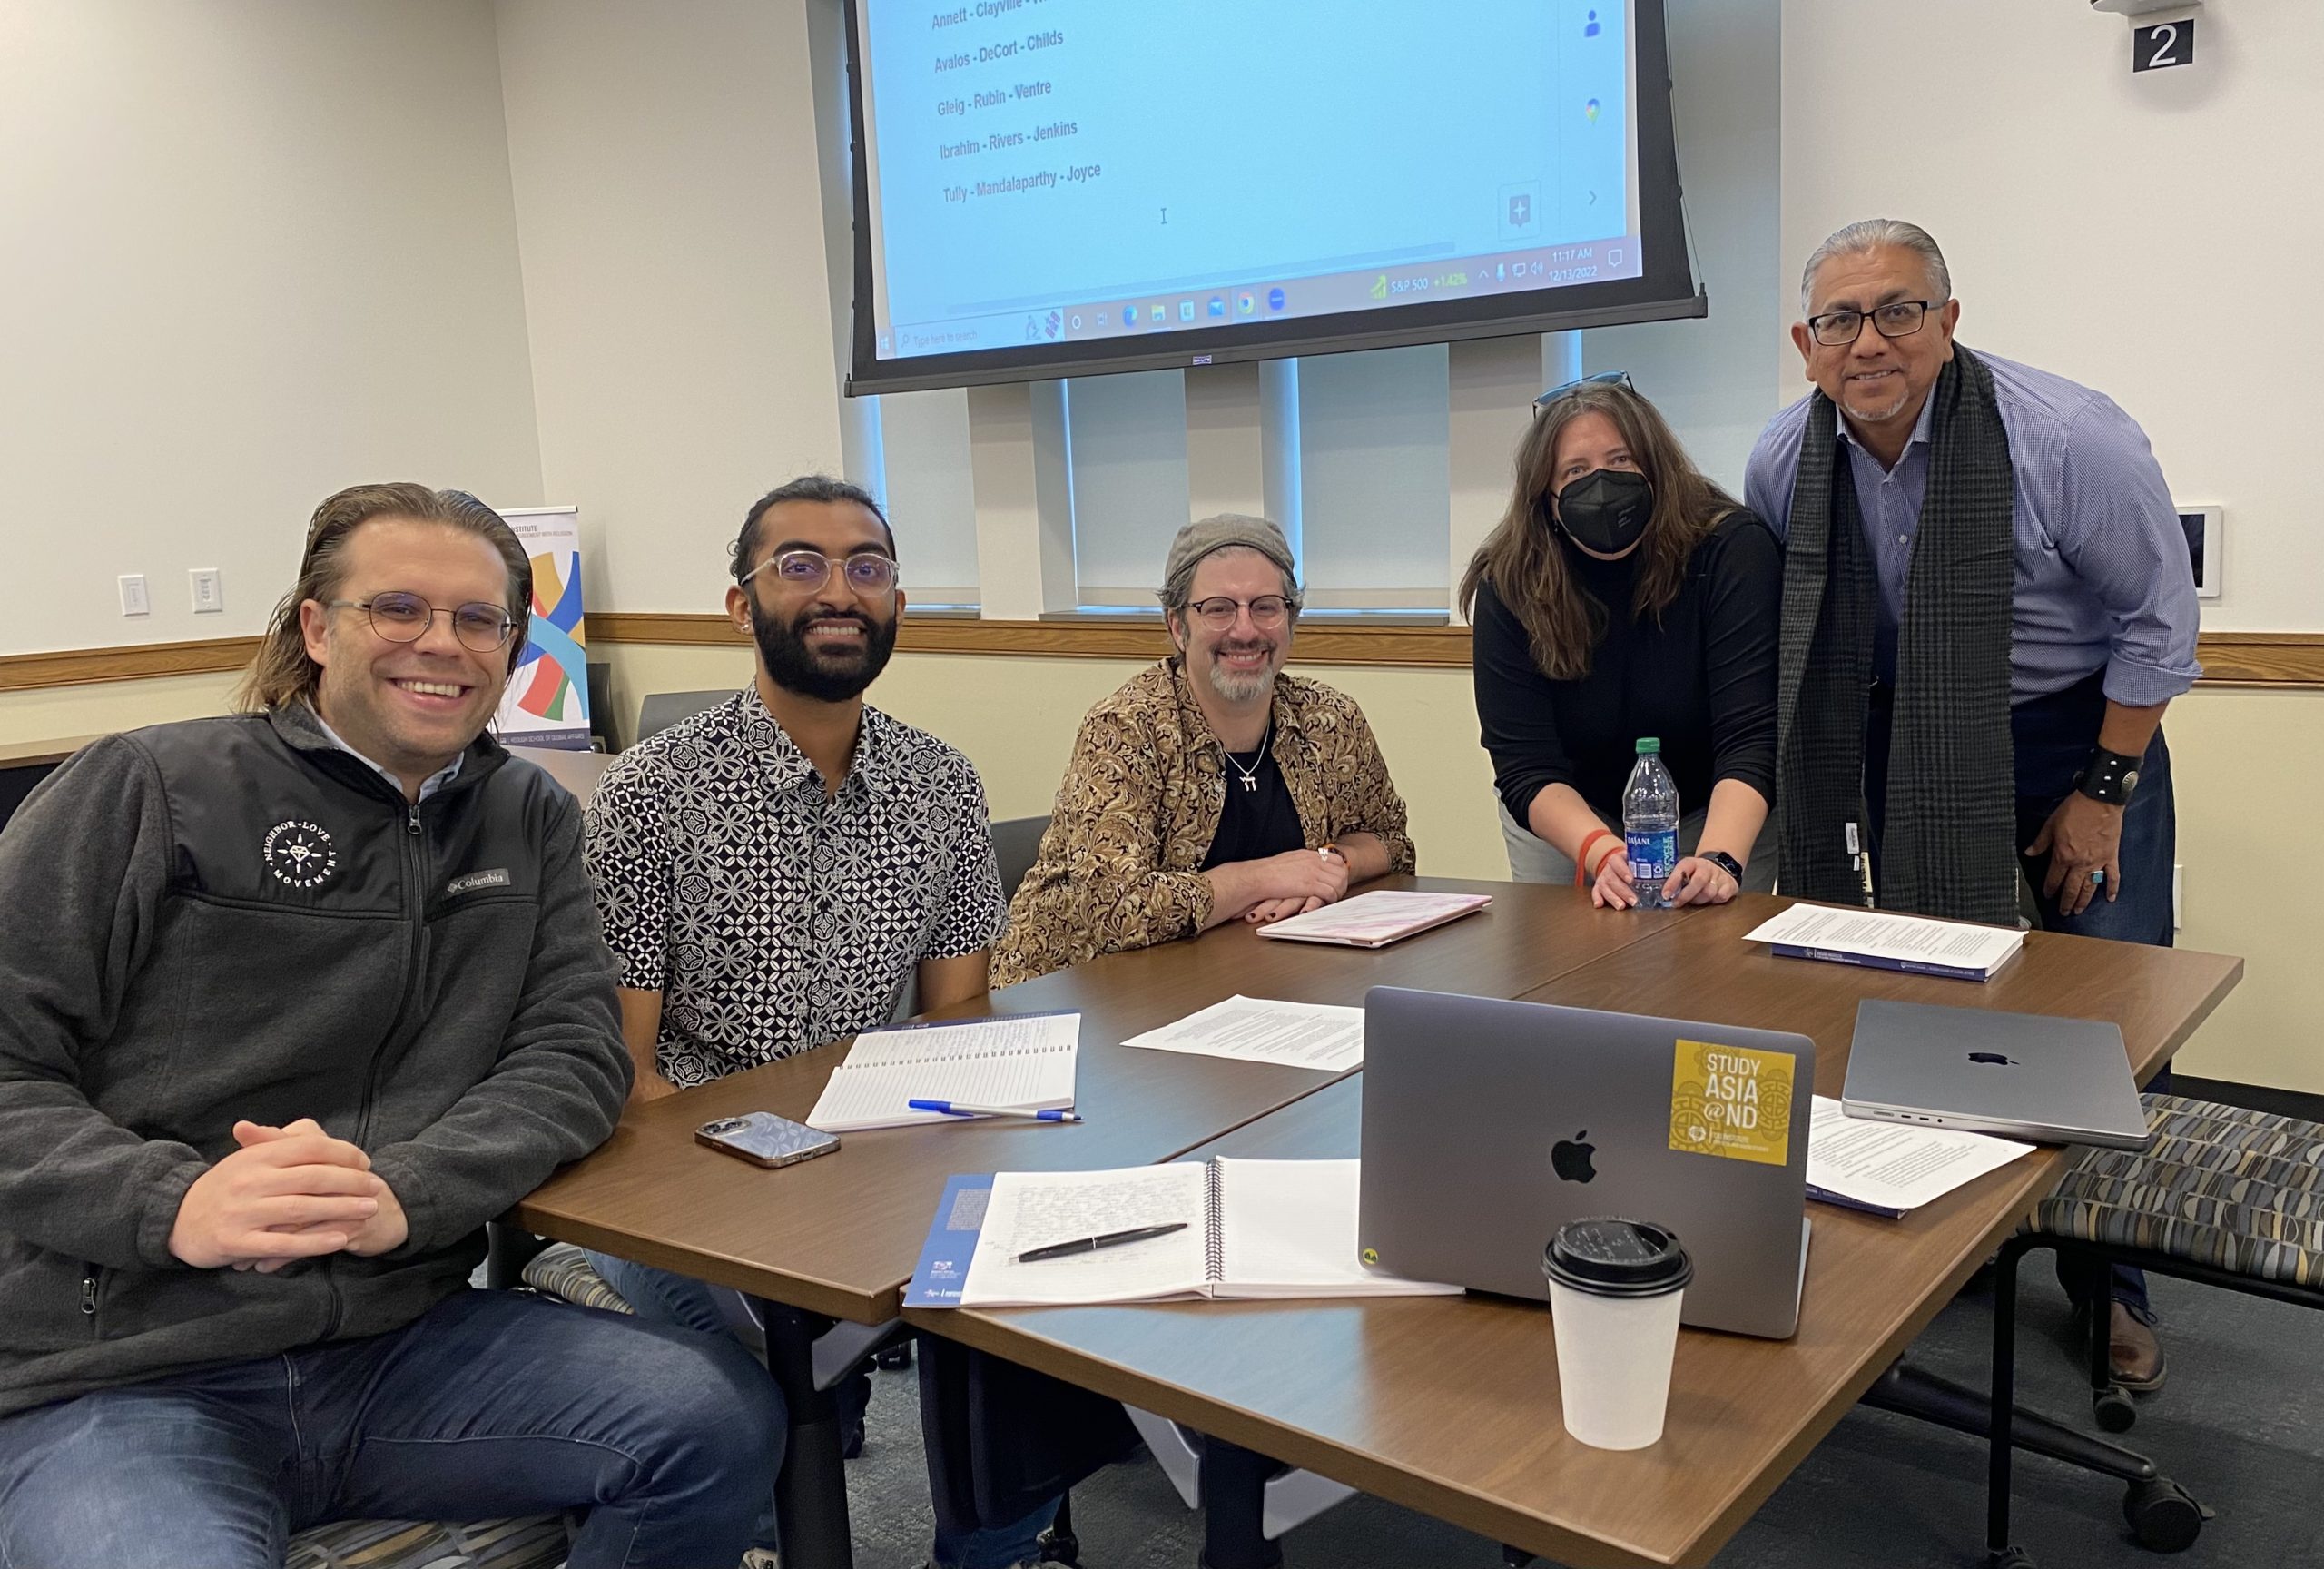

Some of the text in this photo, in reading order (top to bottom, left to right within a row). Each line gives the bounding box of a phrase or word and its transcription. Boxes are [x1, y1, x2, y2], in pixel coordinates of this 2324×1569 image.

[932, 7, 967, 30] Annett
[935, 54, 970, 73] Avalos
[980, 41, 1018, 63] DeCort
[1028, 30, 1064, 51] Childs
[2148, 24, 2178, 68] 2
[938, 98, 965, 115] Gleig
[974, 90, 1006, 109] Rubin
[1015, 81, 1051, 100] Ventre
[940, 140, 980, 160] Ibrahim
[989, 133, 1023, 150] Rivers
[1033, 121, 1078, 142] Jenkins
[943, 186, 967, 203] Tully
[977, 171, 1057, 193] Mandalaparthy
[1067, 164, 1101, 183] Joyce
[1552, 247, 1592, 262] 11:17 AM
[1391, 280, 1410, 293] S&P
[1413, 277, 1428, 290] 500
[1549, 265, 1598, 282] 12/13/2022
[913, 335, 930, 349] Type
[956, 330, 978, 341] search
[273, 850, 337, 888] MOVEMENT
[458, 873, 504, 890] Columbia
[1707, 1053, 1761, 1078] STUDY
[1705, 1073, 1758, 1105] ASIA
